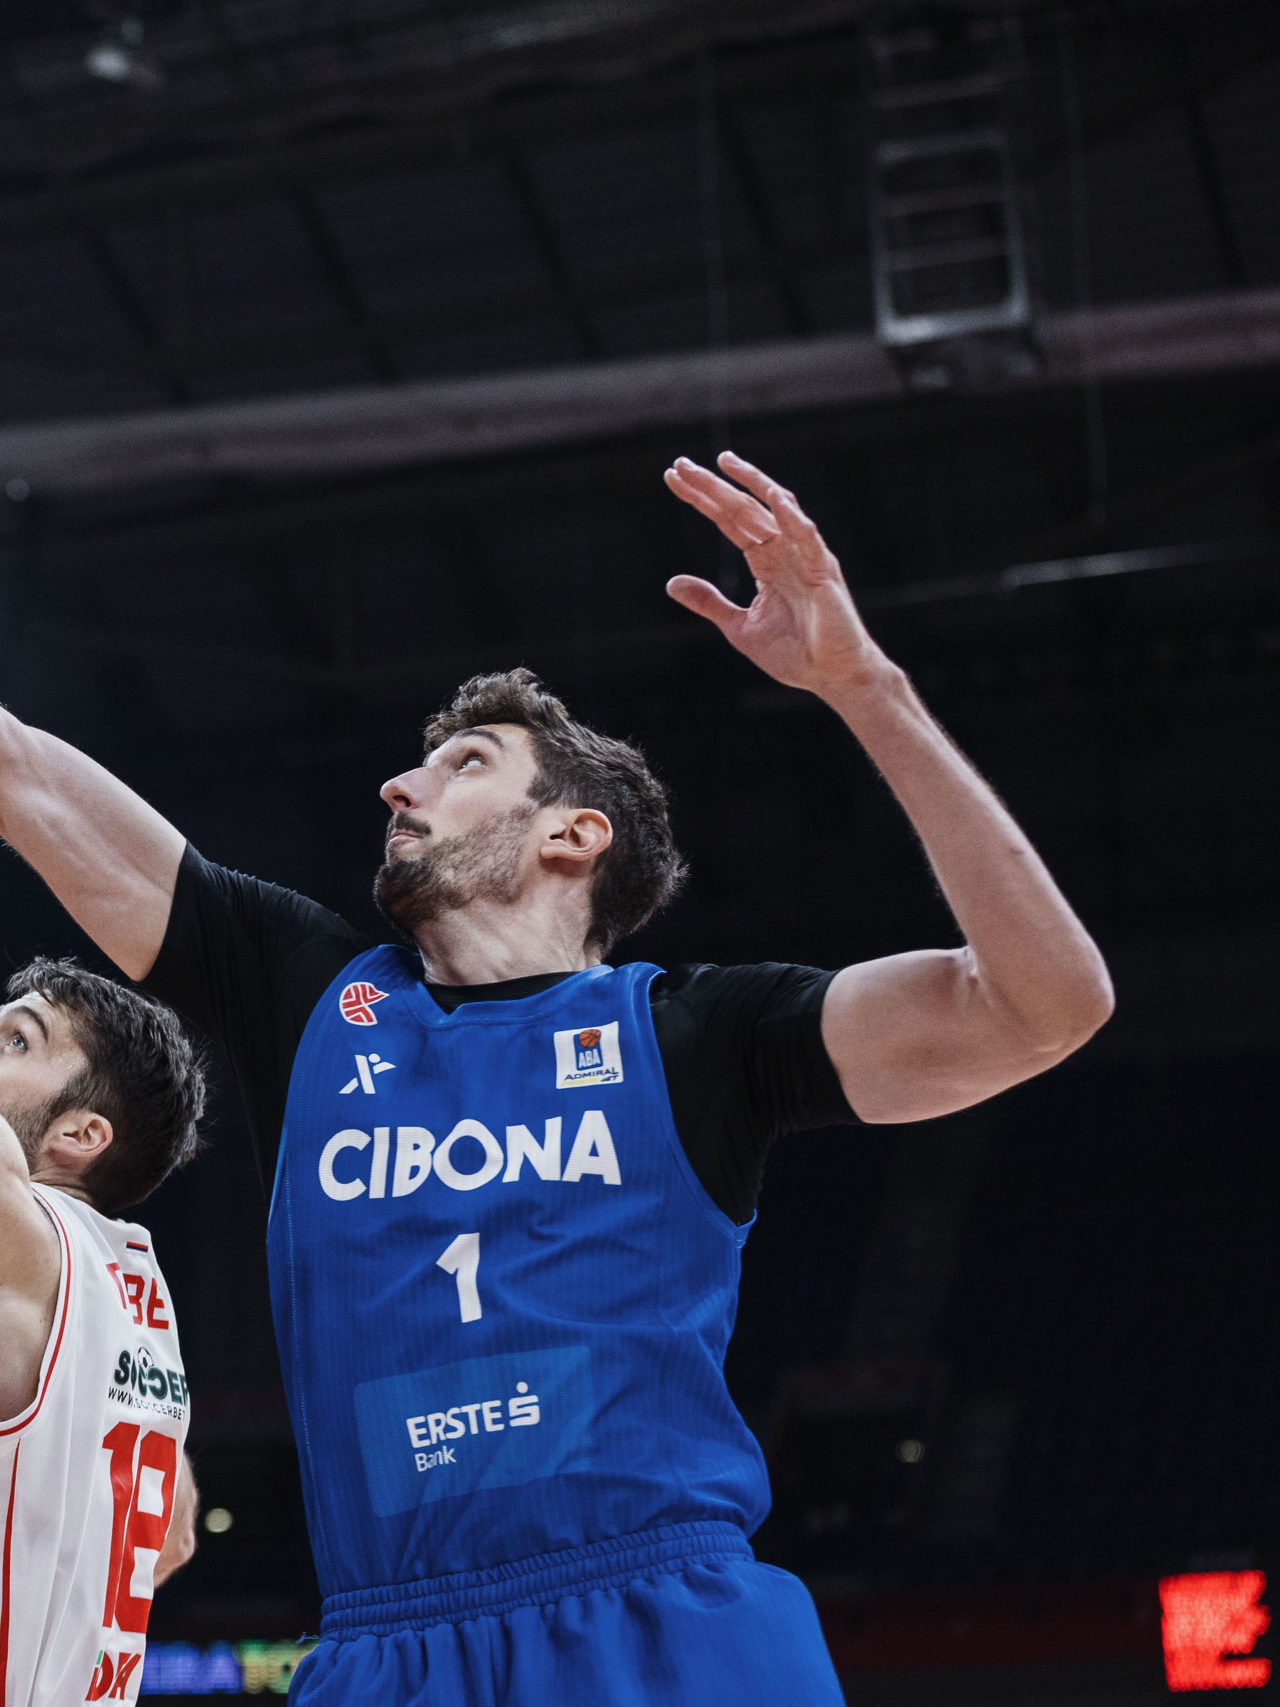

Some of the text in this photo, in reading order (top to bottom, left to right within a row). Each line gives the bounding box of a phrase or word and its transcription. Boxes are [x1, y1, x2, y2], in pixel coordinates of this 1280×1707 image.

[564, 1066, 620, 1081] ADMIRAL
[578, 1048, 601, 1069] ABA
[318, 1109, 623, 1202] CIBONA
[435, 1232, 483, 1324] 1
[405, 1399, 506, 1449] ERSTE
[414, 1444, 457, 1473] Bank
[102, 1420, 177, 1635] 18
